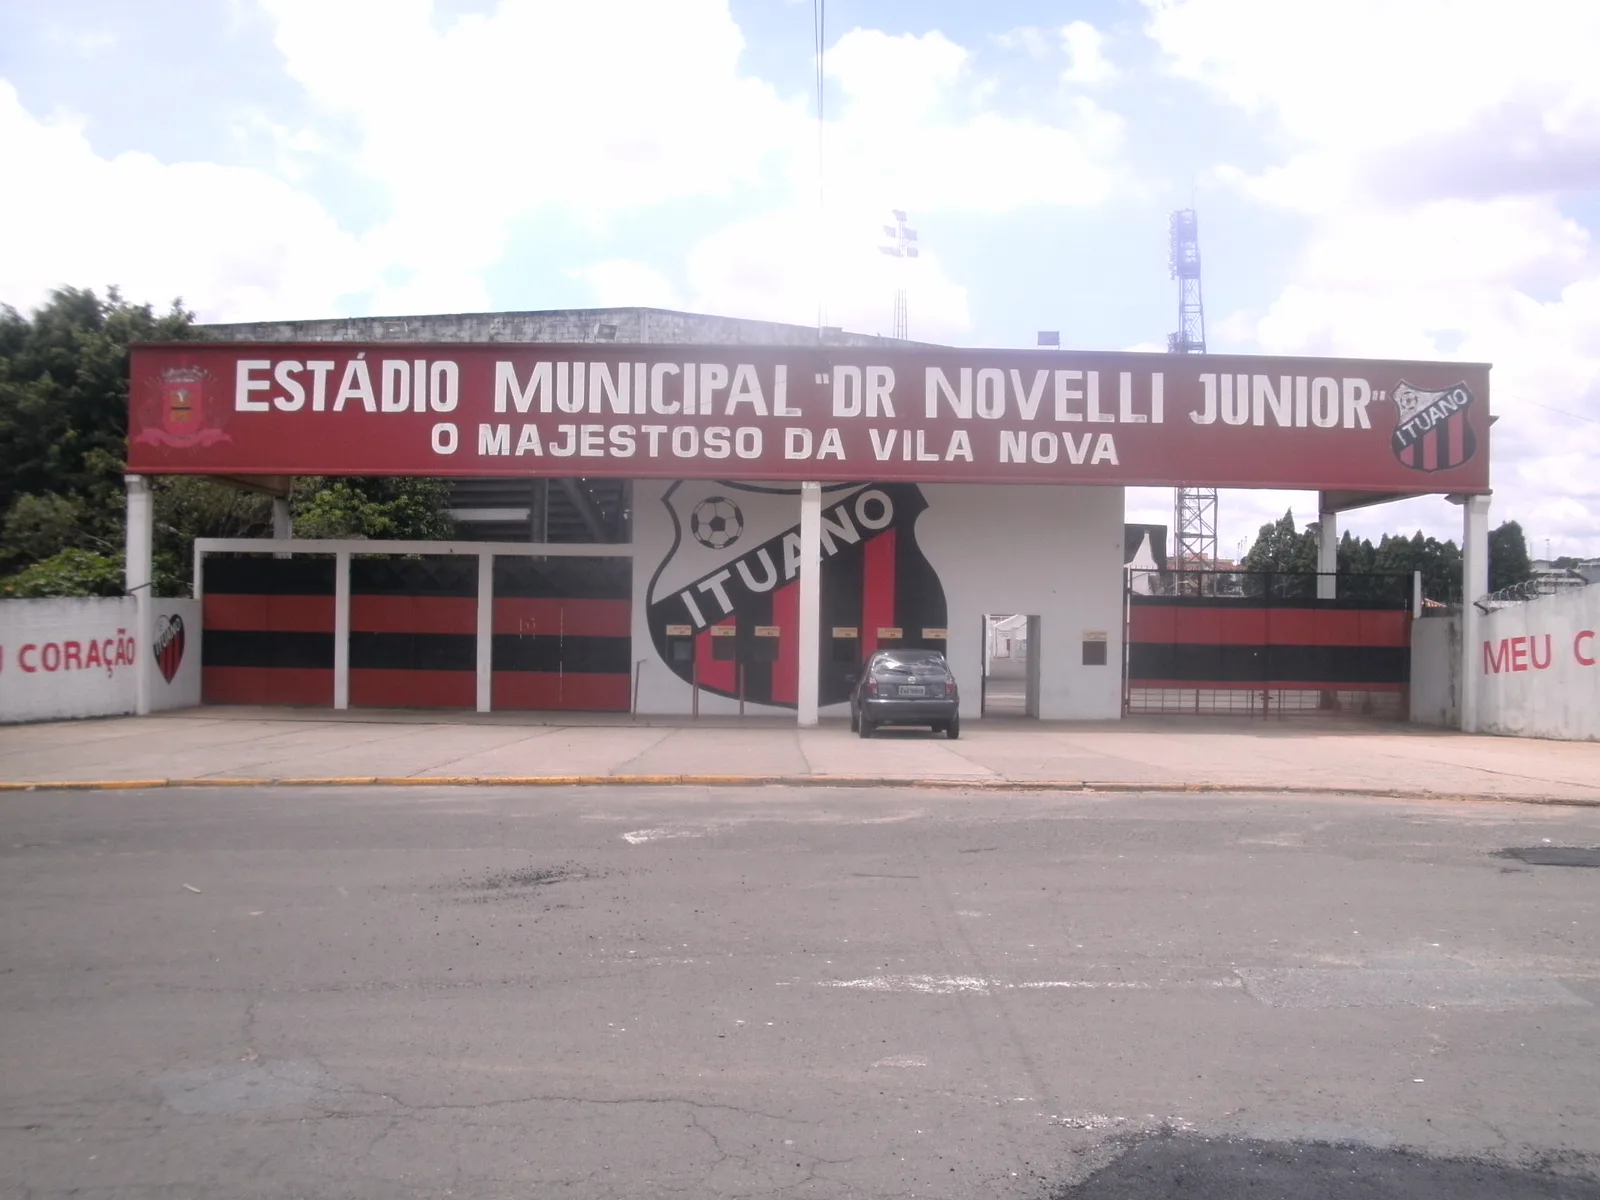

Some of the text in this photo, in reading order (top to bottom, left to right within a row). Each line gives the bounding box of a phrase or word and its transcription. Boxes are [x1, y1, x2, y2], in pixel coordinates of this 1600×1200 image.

[235, 352, 459, 412] ESTÁDIO
[494, 361, 802, 417] MUNICIPAL
[925, 367, 1164, 423] NOVELLI
[431, 422, 1120, 465] O MAJESTOSO DA VILA NOVA
[1396, 389, 1468, 446] ITUANO
[681, 489, 894, 628] ITUANO
[18, 628, 136, 678] CORAÇÃO
[1483, 634, 1552, 675] MEU
